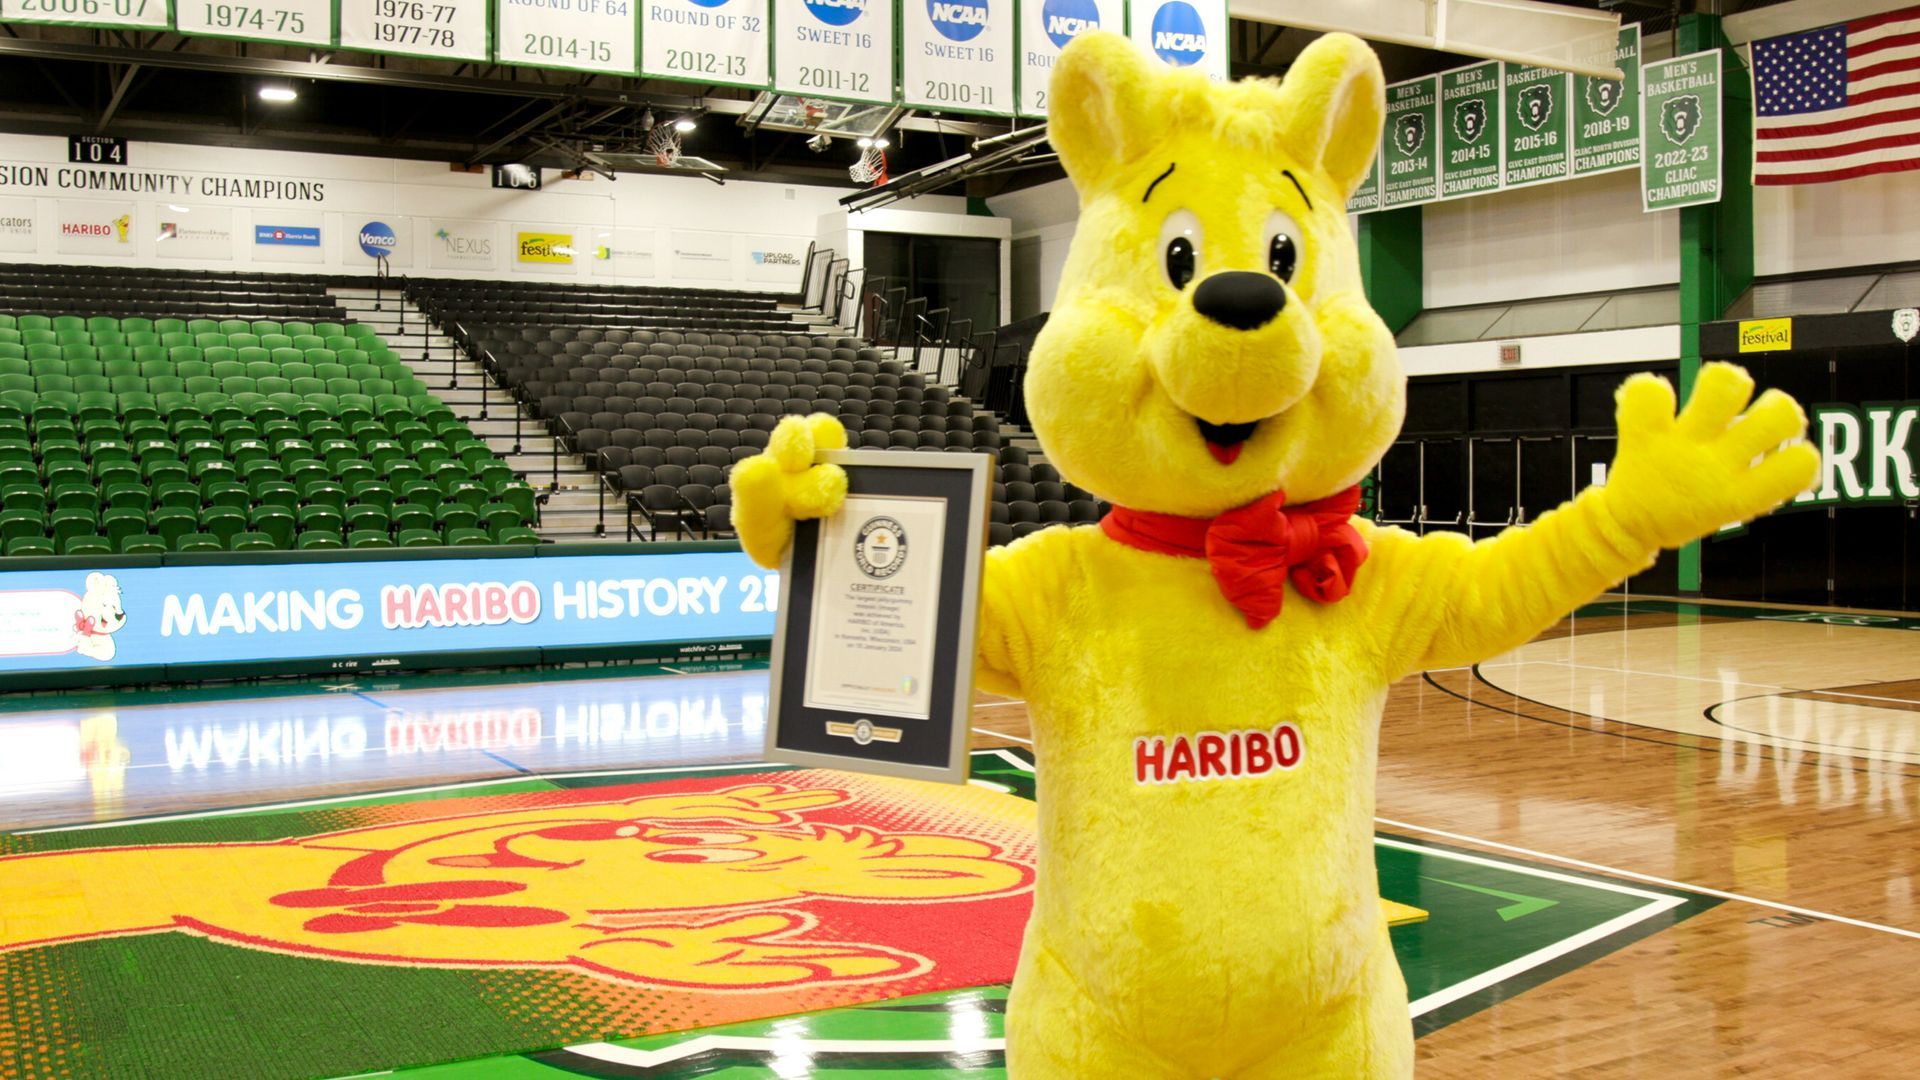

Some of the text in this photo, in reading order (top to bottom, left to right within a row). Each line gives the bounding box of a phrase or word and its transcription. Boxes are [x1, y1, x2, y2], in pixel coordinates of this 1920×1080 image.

[205, 3, 305, 34] 1974-75
[374, 0, 457, 24] 1976-77
[578, 0, 600, 13] OF
[606, 0, 628, 17] 64
[932, 2, 988, 27] NCAA
[651, 6, 761, 33] ROUND OF 32
[374, 22, 456, 48] 1977-78
[797, 26, 872, 49] SWEET 16
[1155, 31, 1207, 52] NCAA
[524, 33, 612, 62] 2014-15
[924, 42, 994, 63] SWEET 16
[666, 49, 747, 76] 2012-13
[1027, 52, 1058, 69] ROU
[1664, 61, 1698, 80] MEN'S
[799, 66, 870, 93] 2011-12
[1456, 69, 1483, 85] MEN'S
[1647, 73, 1716, 97] BASKETBALL
[925, 80, 993, 105] 2010-11
[1396, 85, 1421, 99] MEN'S
[1444, 79, 1498, 100] BASKETBALL
[1386, 94, 1434, 113] BASKETBALL
[1583, 116, 1630, 139] 2018-19
[81, 136, 115, 144] SECTION
[1514, 131, 1557, 152] 2015-16
[1612, 137, 1640, 150] DIVISION
[75, 142, 121, 163] 104
[1451, 144, 1491, 164] 2014-15
[1538, 152, 1564, 164] DIVISION
[1575, 147, 1640, 171] CHAMPIONS
[1655, 146, 1709, 168] 2022-23
[1391, 156, 1428, 175] 2013-14
[1506, 161, 1566, 184] CHAMPIONS
[1665, 166, 1698, 184] GLIAC
[0, 165, 324, 202] SION COMMUNITY CHAMPIONS
[1443, 174, 1499, 194] CHAMPIONS
[1648, 179, 1717, 202] CHAMPIONS
[1346, 194, 1378, 210] MPIONS
[1385, 185, 1436, 204] CHAMPIONS
[62, 223, 111, 236] HARIBO
[360, 232, 395, 246] Vonco
[446, 238, 491, 255] NEXUS
[521, 241, 571, 257] festi
[763, 252, 793, 260] UPLOAD
[763, 258, 801, 266] PARTNERS
[1742, 329, 1789, 347] festival
[1796, 408, 1920, 504] RK
[161, 588, 364, 637] MAKING
[382, 581, 541, 628] HARIBO
[553, 575, 727, 620] HISTORY
[1135, 723, 1302, 784] HARIBO
